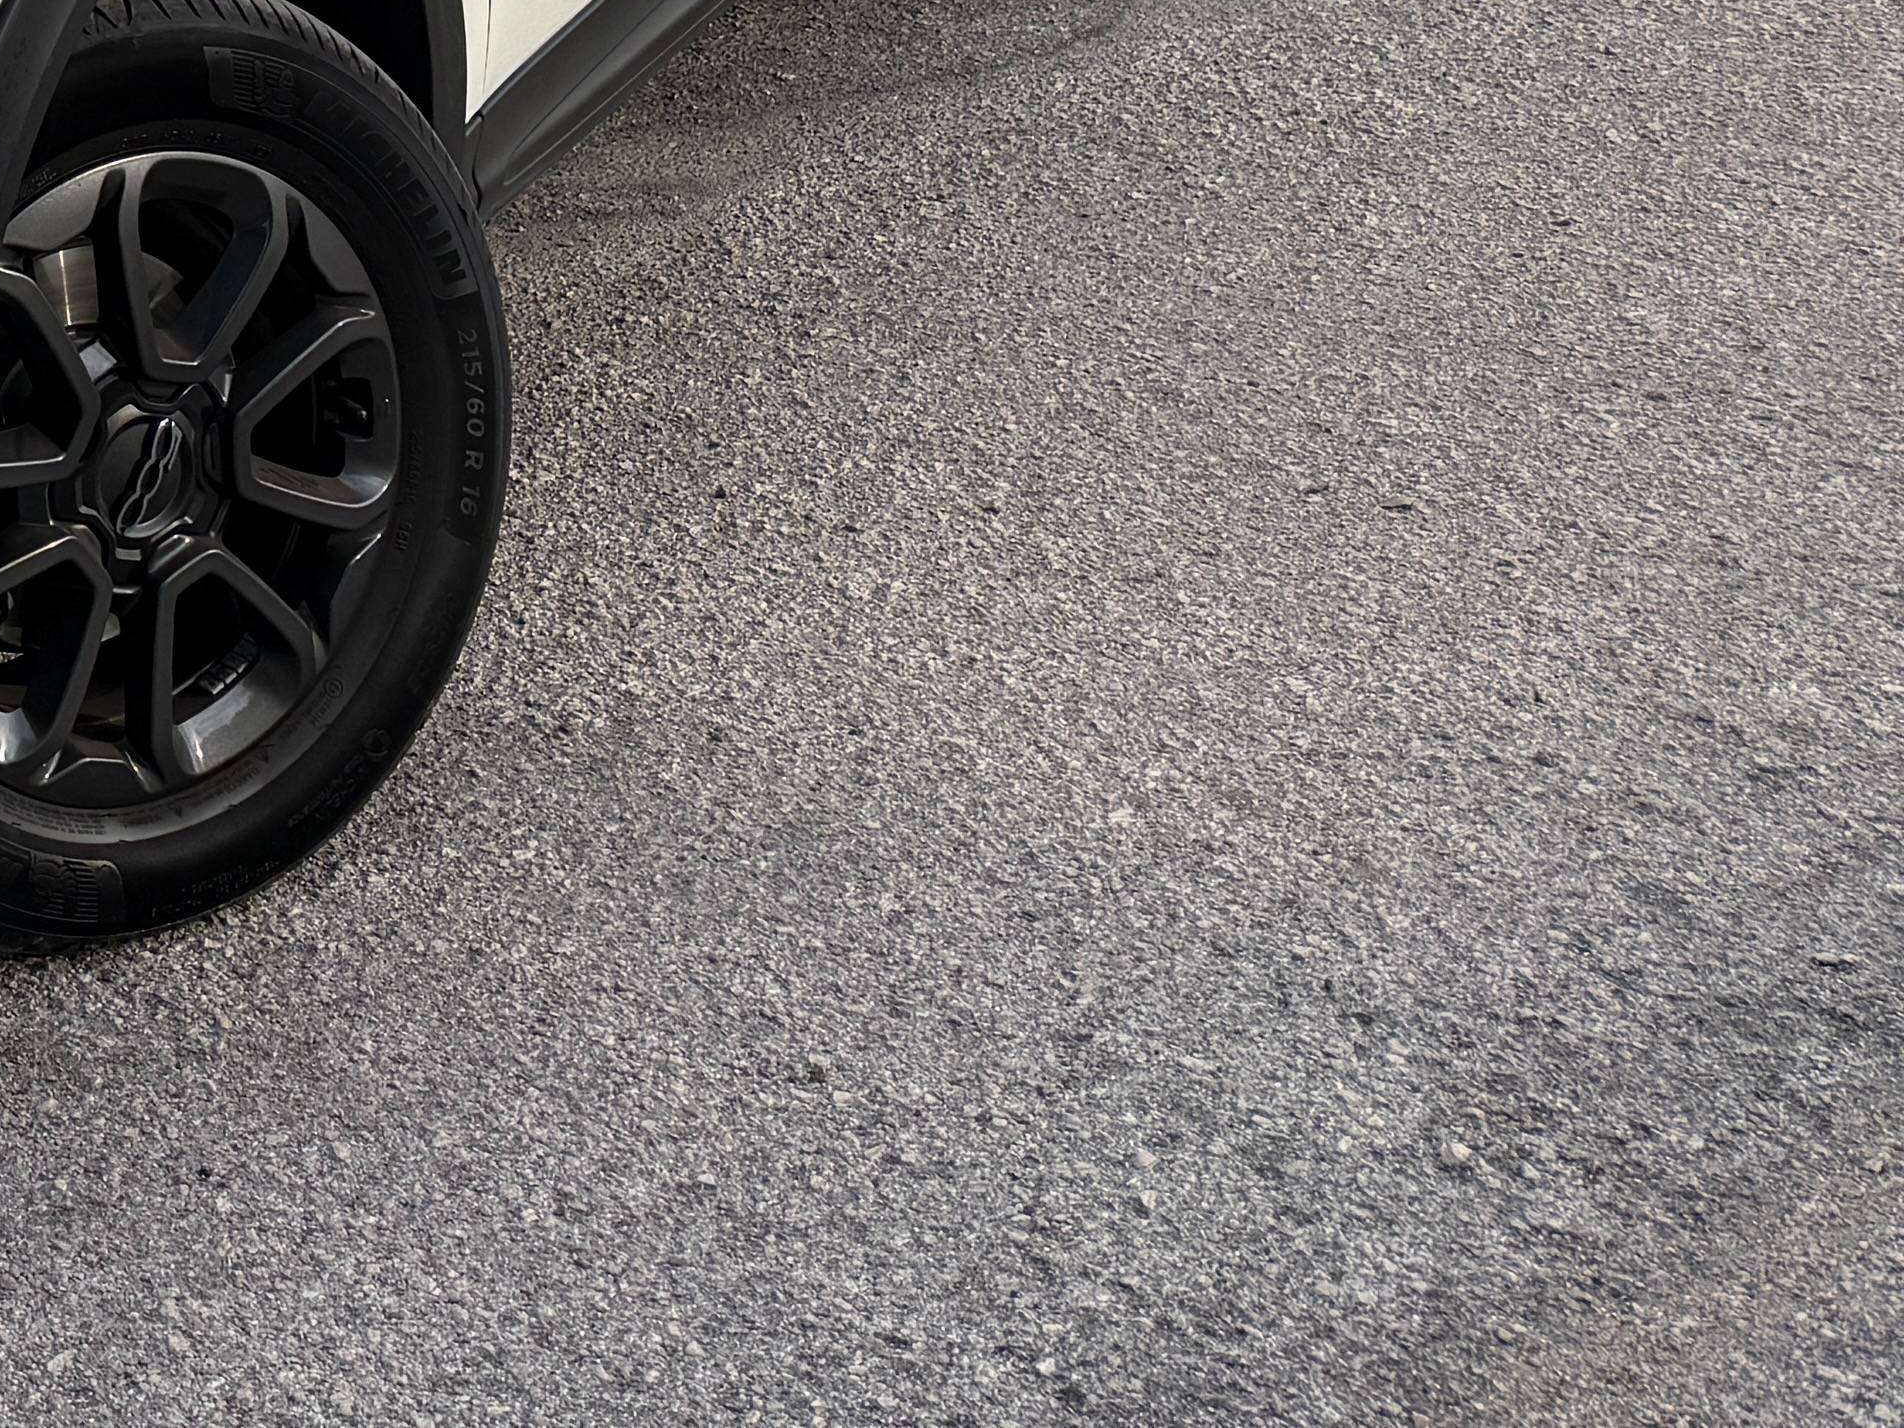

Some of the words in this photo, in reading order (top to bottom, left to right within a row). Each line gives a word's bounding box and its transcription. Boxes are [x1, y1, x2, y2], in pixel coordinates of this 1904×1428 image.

[304, 91, 468, 288] MICHELIN
[455, 328, 486, 440] 215/60
[464, 452, 485, 472] R
